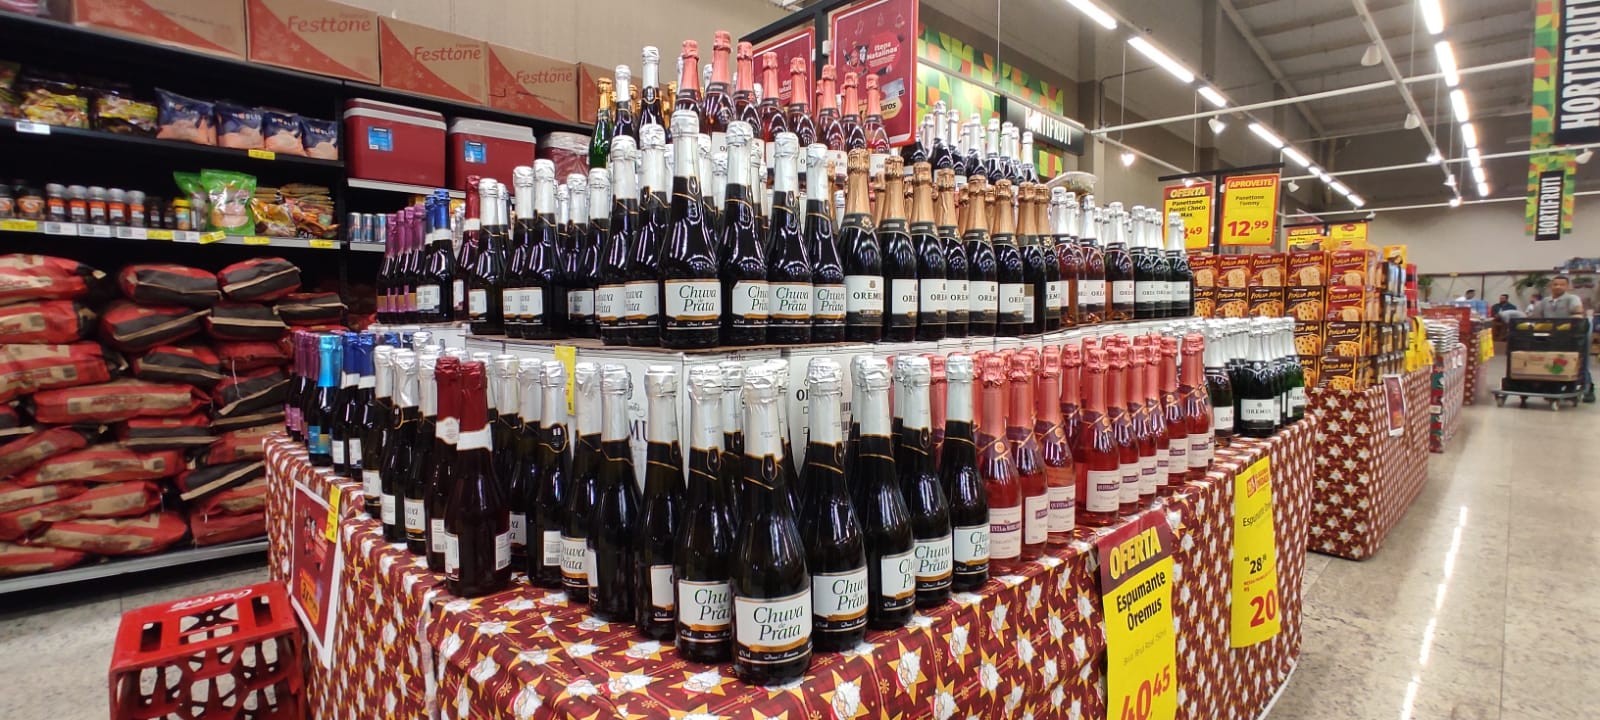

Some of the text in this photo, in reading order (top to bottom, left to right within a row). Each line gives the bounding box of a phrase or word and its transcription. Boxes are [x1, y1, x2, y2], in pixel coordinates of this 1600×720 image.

[287, 15, 371, 33] Festtone
[414, 46, 481, 62] Festtone
[515, 70, 573, 85] Festtone
[1229, 179, 1273, 188] APROVEITE
[1537, 176, 1562, 235] HORTIFRUTI
[679, 284, 717, 300] Chuva
[776, 286, 809, 300] Chuva
[683, 298, 715, 312] Prata
[779, 299, 807, 312] Prata
[1109, 526, 1162, 580] OFERTA
[694, 588, 727, 605] Chu
[1116, 571, 1167, 613] Espumante
[753, 605, 803, 624] Chuva
[1127, 597, 1162, 631] Oremus
[759, 624, 801, 641] Prata
